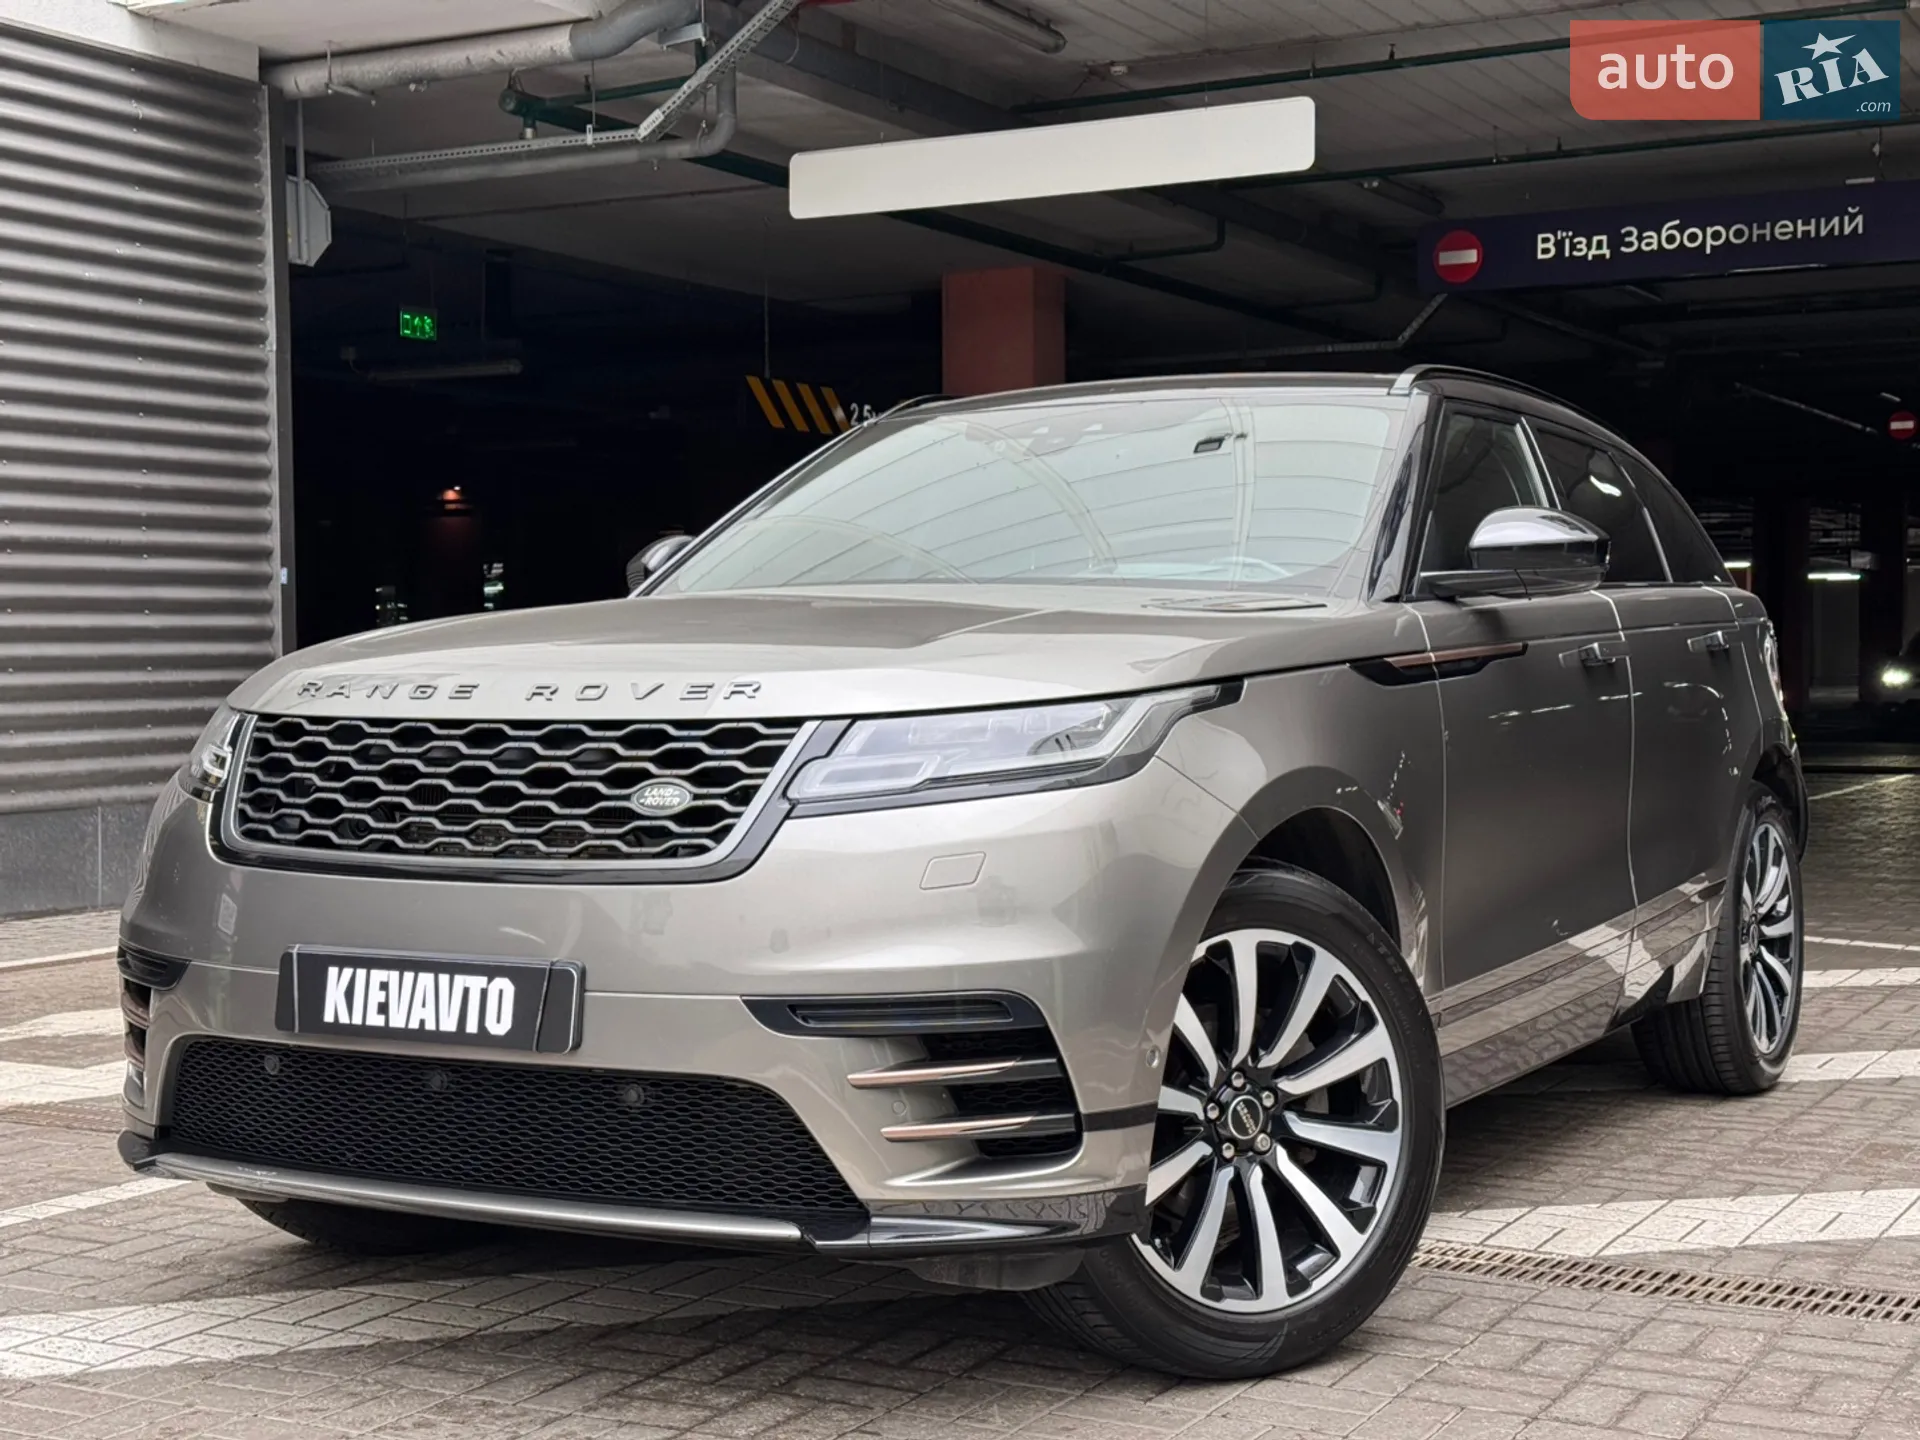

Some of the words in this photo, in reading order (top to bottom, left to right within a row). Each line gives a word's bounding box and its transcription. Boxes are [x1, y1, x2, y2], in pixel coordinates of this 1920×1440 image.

[1537, 229, 1611, 260] В'їзд
[1620, 207, 1864, 254] Заборонений
[297, 679, 480, 700] RANGE
[525, 680, 762, 701] ROVER
[644, 797, 680, 806] ROVER
[323, 966, 515, 1036] KIEVAVTO
